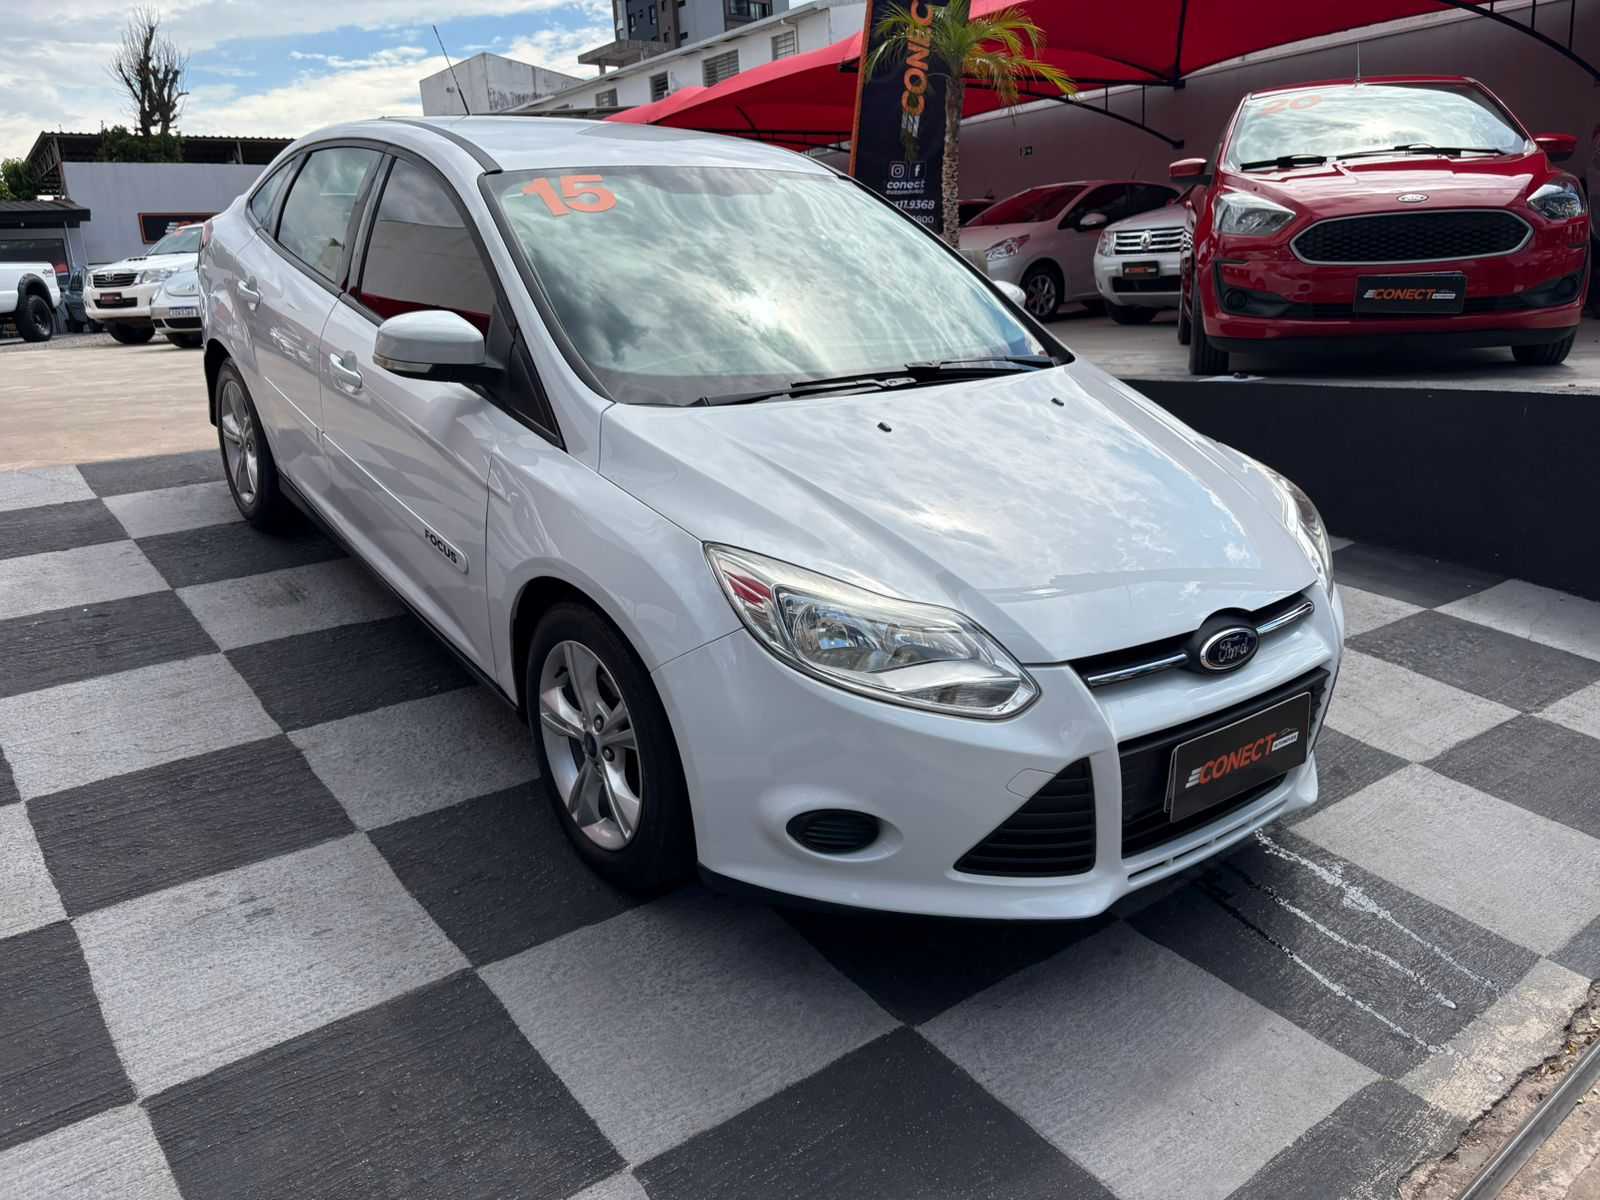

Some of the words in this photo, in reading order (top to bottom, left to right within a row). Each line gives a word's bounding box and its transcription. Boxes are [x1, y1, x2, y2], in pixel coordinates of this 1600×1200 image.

[522, 174, 617, 217] 15
[886, 180, 926, 190] conect
[1375, 288, 1437, 300] CONECT
[424, 528, 458, 564] FOCUS
[1218, 635, 1250, 663] Ford
[1199, 732, 1279, 785] CONECT
